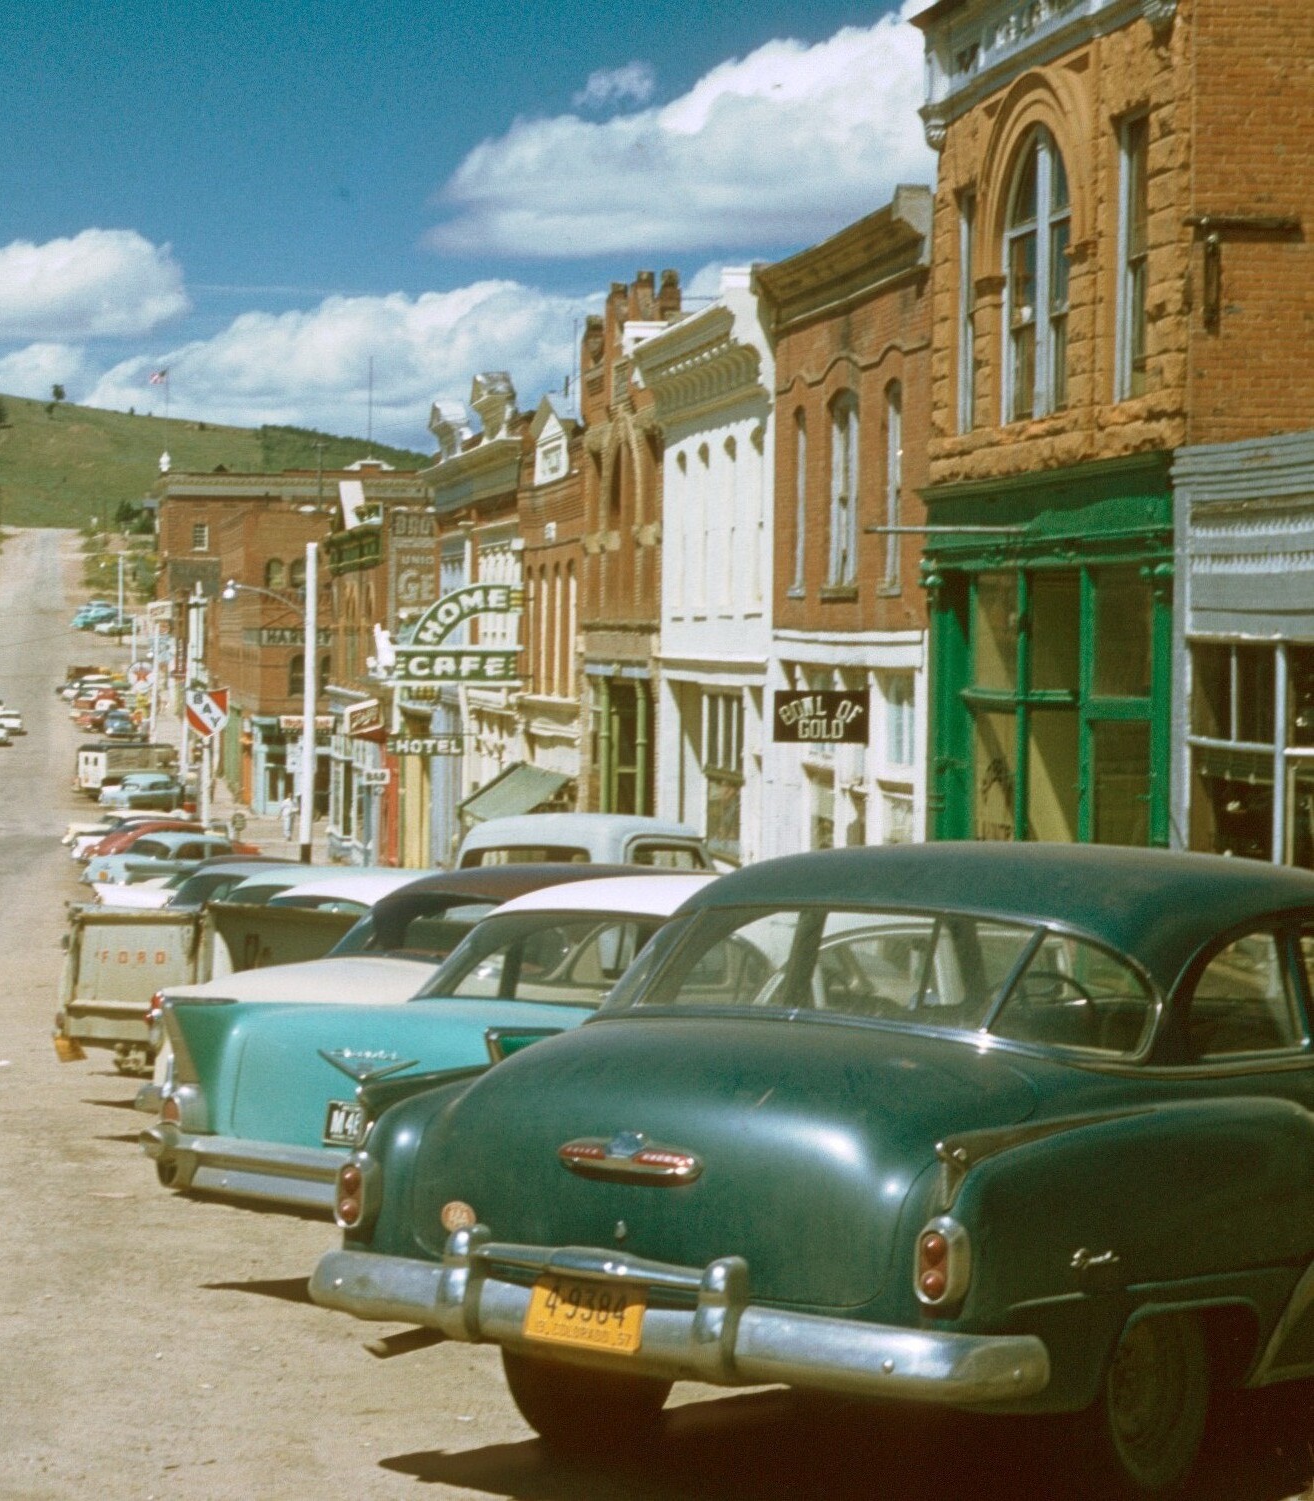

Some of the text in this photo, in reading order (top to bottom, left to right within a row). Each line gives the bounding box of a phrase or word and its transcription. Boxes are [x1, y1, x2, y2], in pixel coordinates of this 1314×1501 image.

[417, 589, 508, 644] HOME
[409, 656, 508, 677] CAFE
[778, 695, 864, 726] BOWL OF
[798, 718, 844, 739] GOLD
[396, 740, 461, 754] HOTEL
[100, 950, 167, 965] FORD
[545, 1284, 626, 1328] 4-9384
